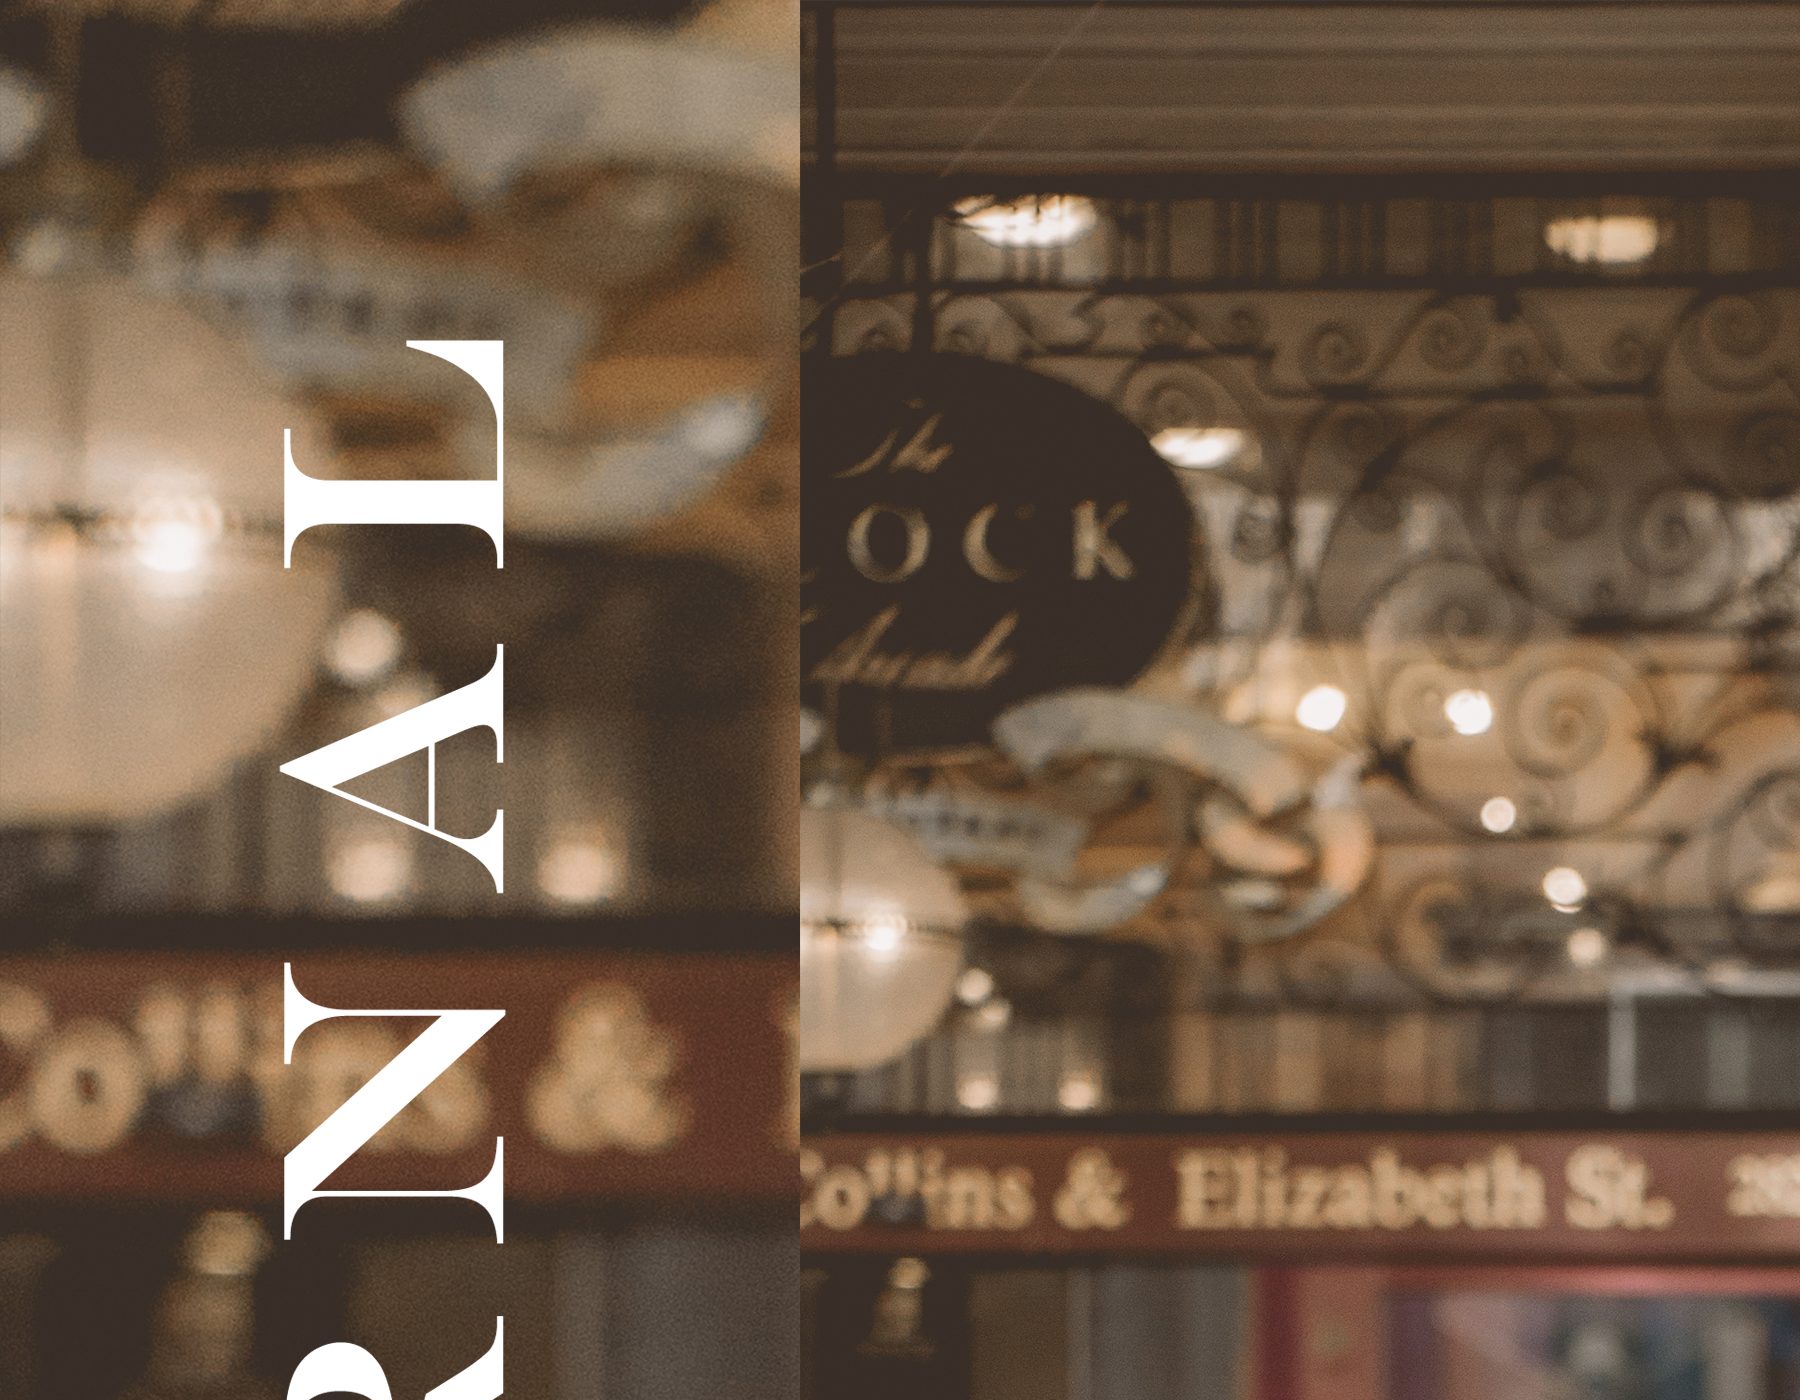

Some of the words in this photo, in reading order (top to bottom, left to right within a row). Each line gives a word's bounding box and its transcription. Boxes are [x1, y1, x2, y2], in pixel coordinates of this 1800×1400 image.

[800, 499, 1135, 583] OCK
[1176, 1143, 1547, 1230] Elizabeth
[1564, 1144, 1676, 1230] St.
